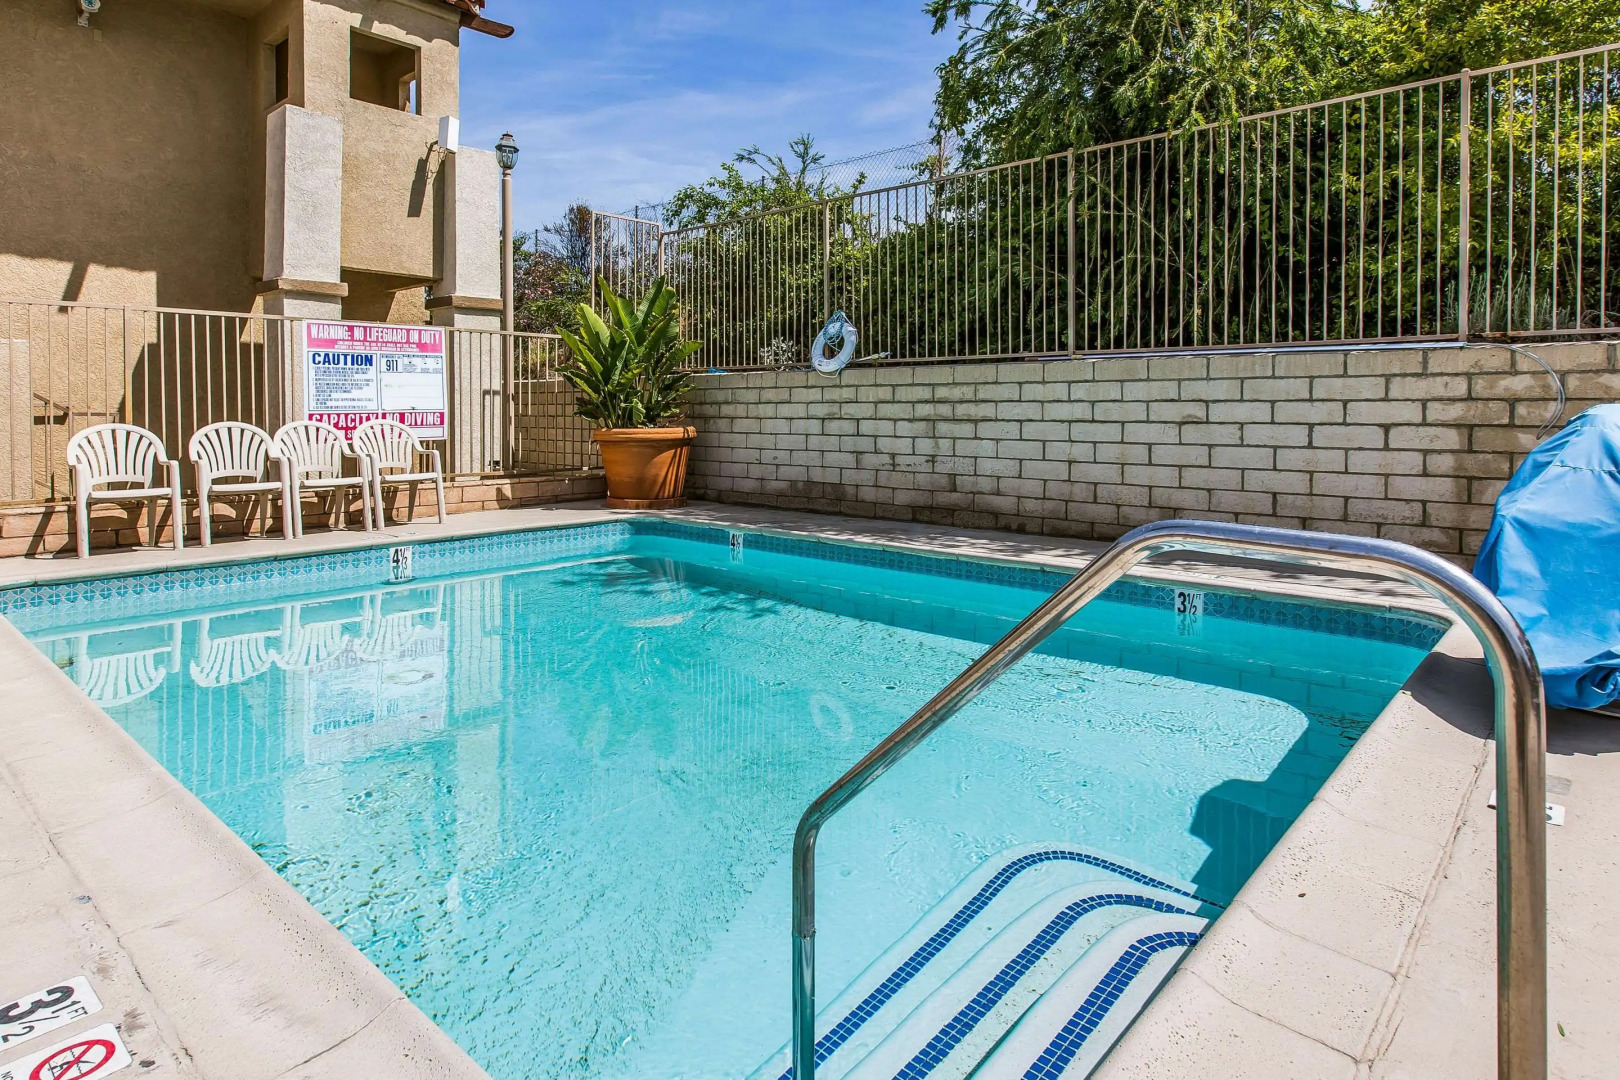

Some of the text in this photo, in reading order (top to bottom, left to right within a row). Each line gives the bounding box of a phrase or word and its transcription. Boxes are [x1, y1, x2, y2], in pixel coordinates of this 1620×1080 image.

[310, 324, 351, 340] WARNING:
[353, 326, 364, 341] NO
[367, 327, 406, 343] LIFEGUARD
[409, 330, 419, 344] ON
[421, 330, 440, 345] DUTY
[312, 352, 374, 367] CAUTION
[386, 359, 398, 371] 911
[404, 412, 441, 426] DIVING
[67, 1007, 88, 1020] FT
